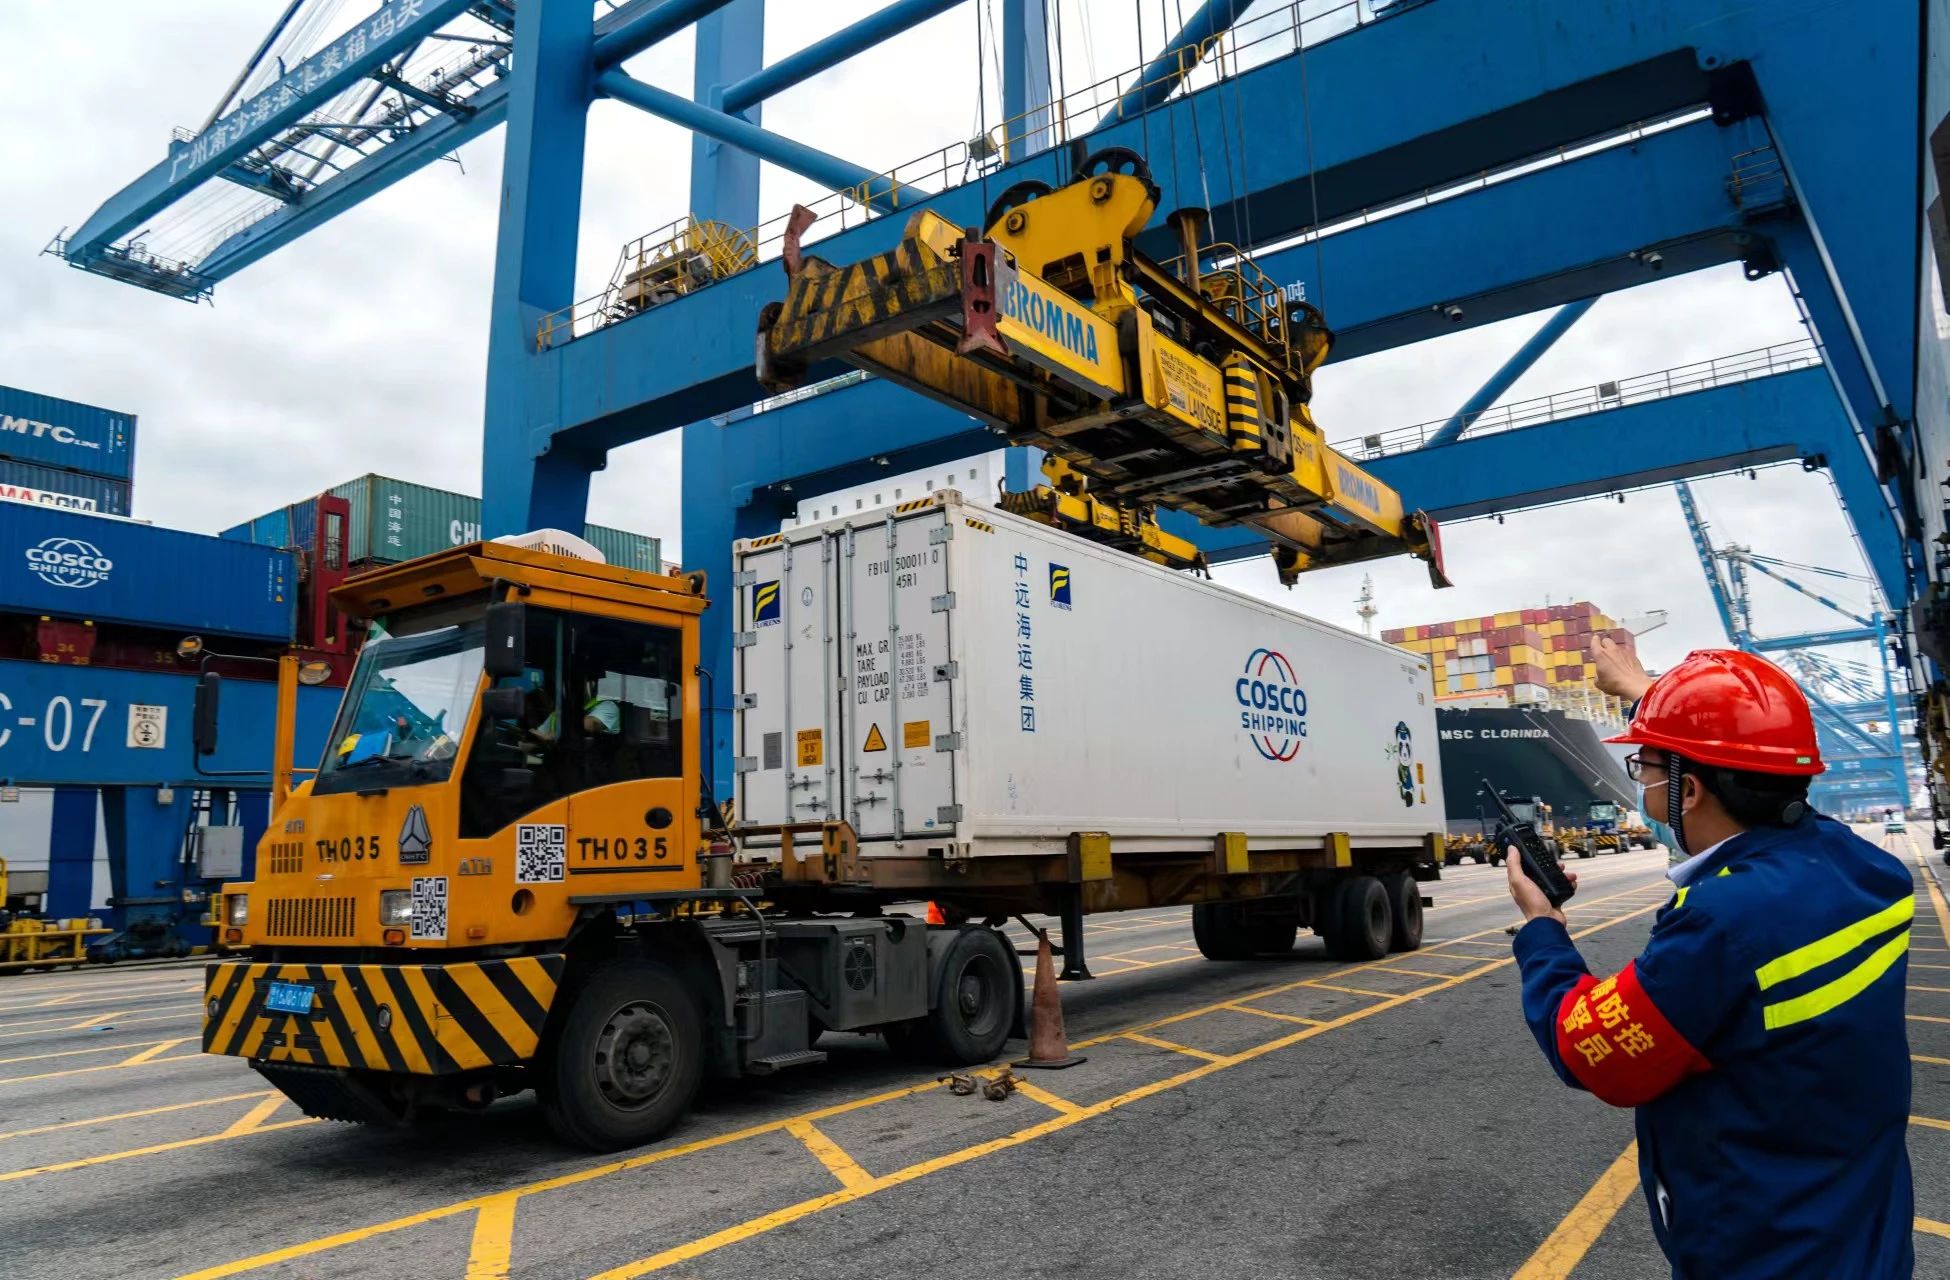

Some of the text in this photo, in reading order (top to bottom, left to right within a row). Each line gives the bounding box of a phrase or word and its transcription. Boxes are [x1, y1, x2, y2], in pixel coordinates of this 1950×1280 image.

[1005, 280, 1099, 366] BROMMA
[0, 413, 76, 443] MTC
[25, 548, 113, 571] COSCO
[895, 552, 927, 571] 500011
[932, 550, 939, 564] 0
[28, 562, 109, 581] SHIPPING
[896, 573, 917, 588] 45R1
[1014, 547, 1036, 733] 中远海运集团
[857, 658, 876, 673] TARE
[857, 672, 889, 689] PAYLOAD
[1236, 678, 1307, 717] COSCO
[1241, 711, 1307, 737] SHIPPING
[1440, 729, 1549, 740] MSC CLORINDA
[316, 835, 380, 862] TH035
[577, 837, 668, 860] TH035
[459, 858, 492, 875] ATH
